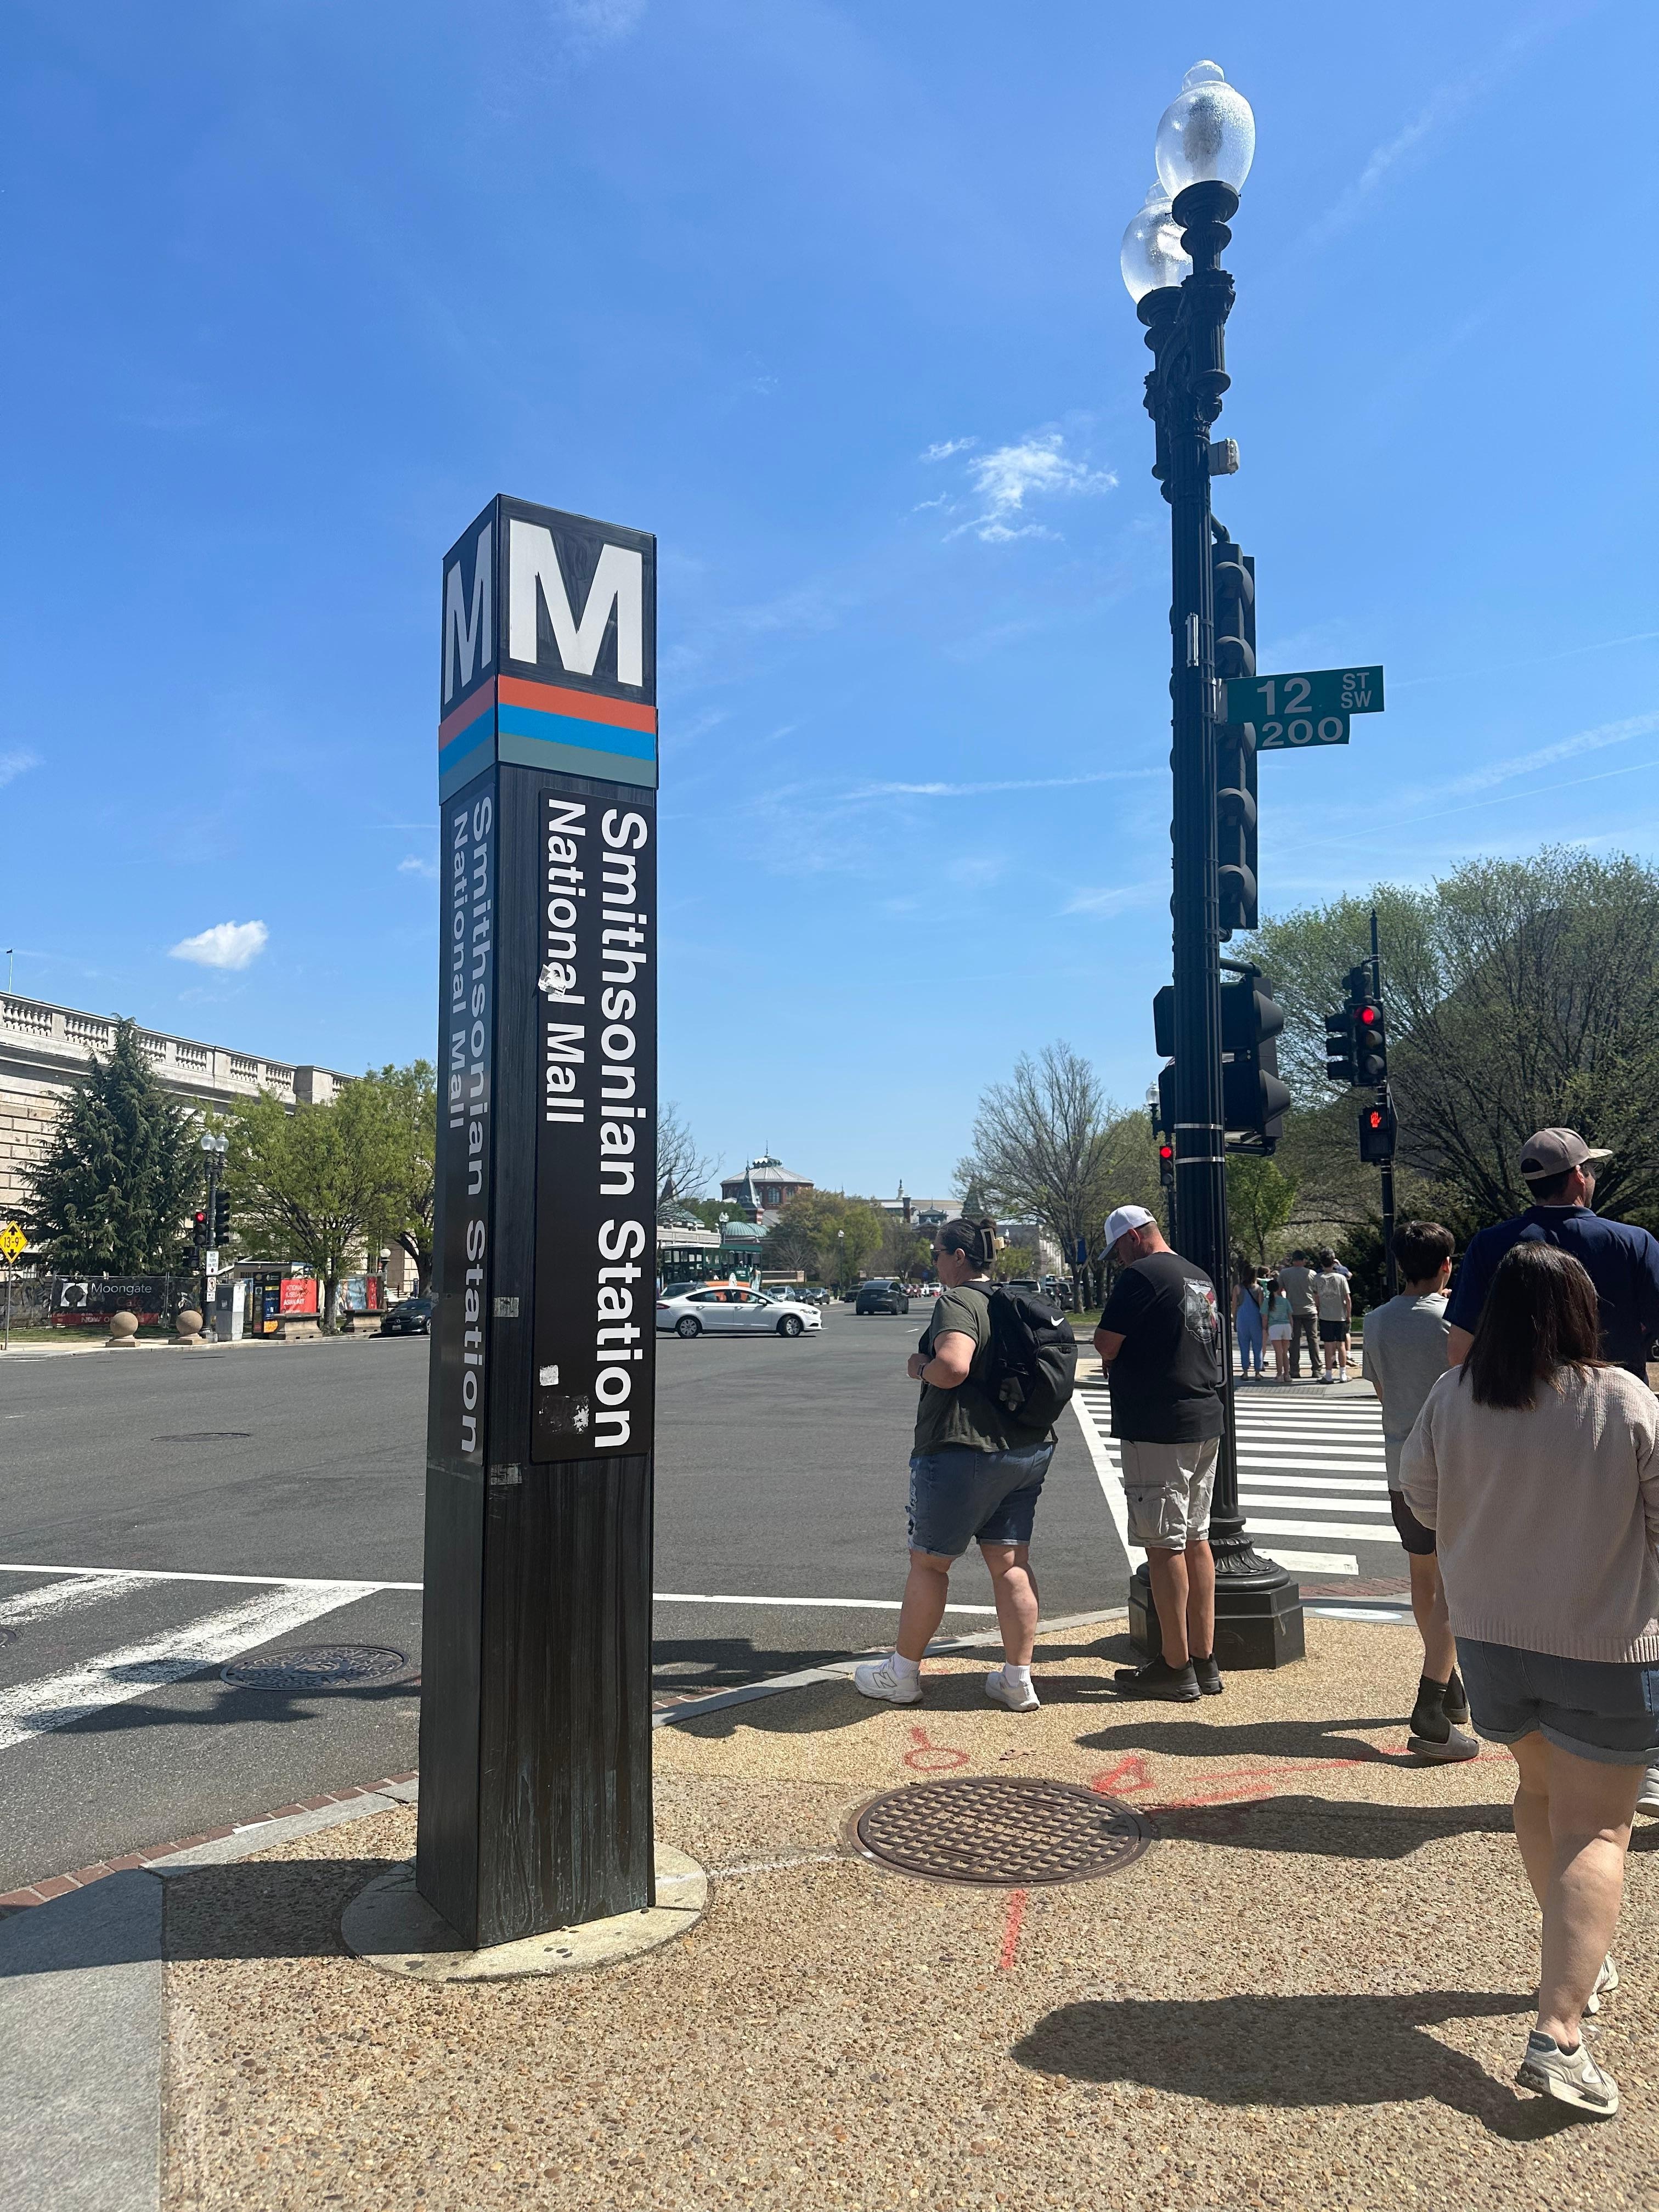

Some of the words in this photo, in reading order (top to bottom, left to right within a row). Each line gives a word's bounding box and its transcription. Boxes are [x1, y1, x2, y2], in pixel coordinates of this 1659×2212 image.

[444, 521, 492, 706] M
[510, 519, 642, 687] M
[1342, 672, 1369, 690] ST
[1257, 677, 1312, 715] 12
[1262, 716, 1343, 747] 200
[1341, 690, 1372, 708] SW
[451, 810, 469, 1014] National
[547, 799, 586, 1005] National
[449, 1029, 466, 1128] Mall
[467, 796, 492, 1195] Smithsonian
[546, 1022, 585, 1123] Mall
[600, 809, 648, 1195] Smithsonian
[91, 1283, 152, 1295] Moongate
[461, 1220, 486, 1453] Station
[594, 1219, 646, 1448] Station
